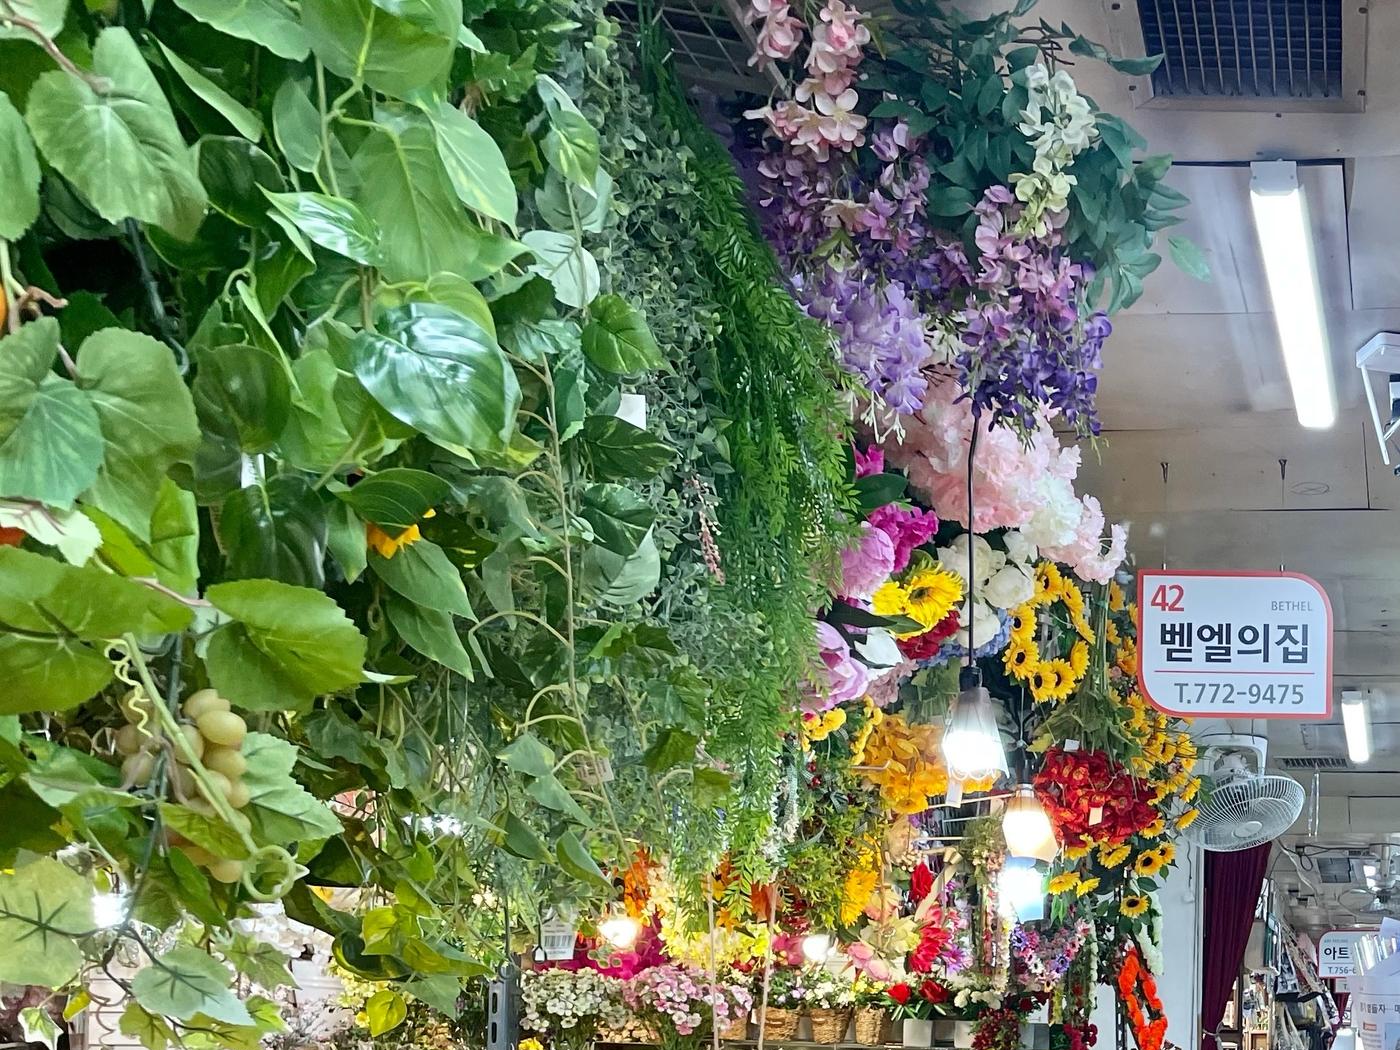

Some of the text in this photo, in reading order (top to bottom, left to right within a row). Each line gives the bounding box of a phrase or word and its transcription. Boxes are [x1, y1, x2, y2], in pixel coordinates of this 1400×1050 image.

[1151, 584, 1185, 612] 42
[1271, 601, 1313, 612] BETHEL
[1160, 622, 1308, 664] 벧엘의집
[1174, 682, 1304, 705] T.772-9475
